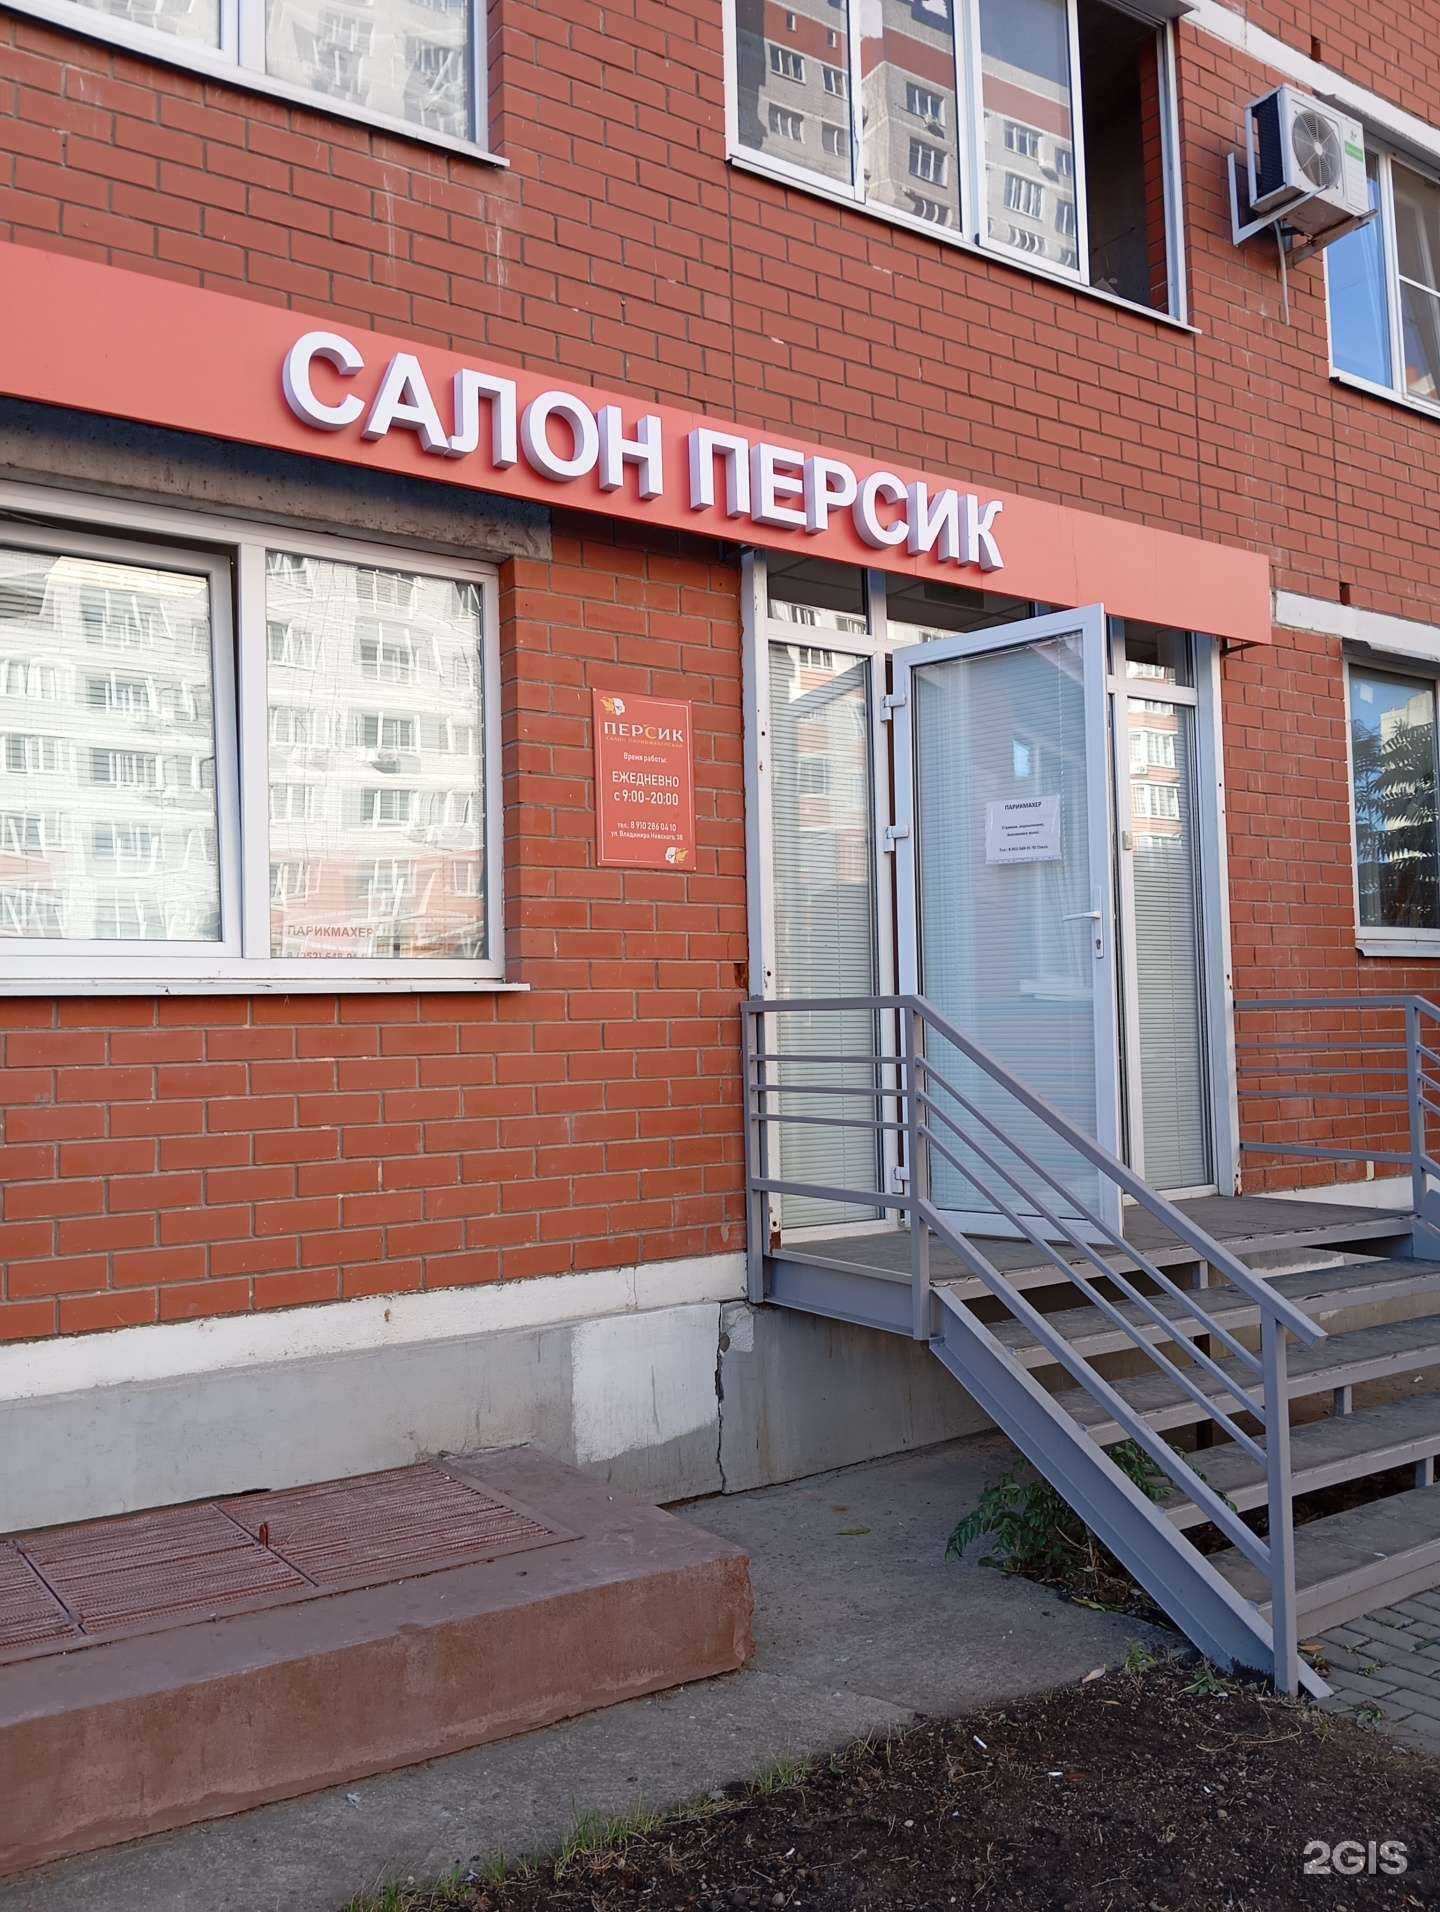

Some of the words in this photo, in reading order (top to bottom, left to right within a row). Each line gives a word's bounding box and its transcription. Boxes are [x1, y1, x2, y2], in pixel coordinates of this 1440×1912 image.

[282, 330, 663, 500] САЛОН
[689, 426, 1006, 573] ПЕРСИК
[604, 722, 684, 742] ПЕРСИК
[612, 771, 679, 787] ЕЖЕДНЕВНО
[287, 924, 374, 938] ПАРИКМАХЕР
